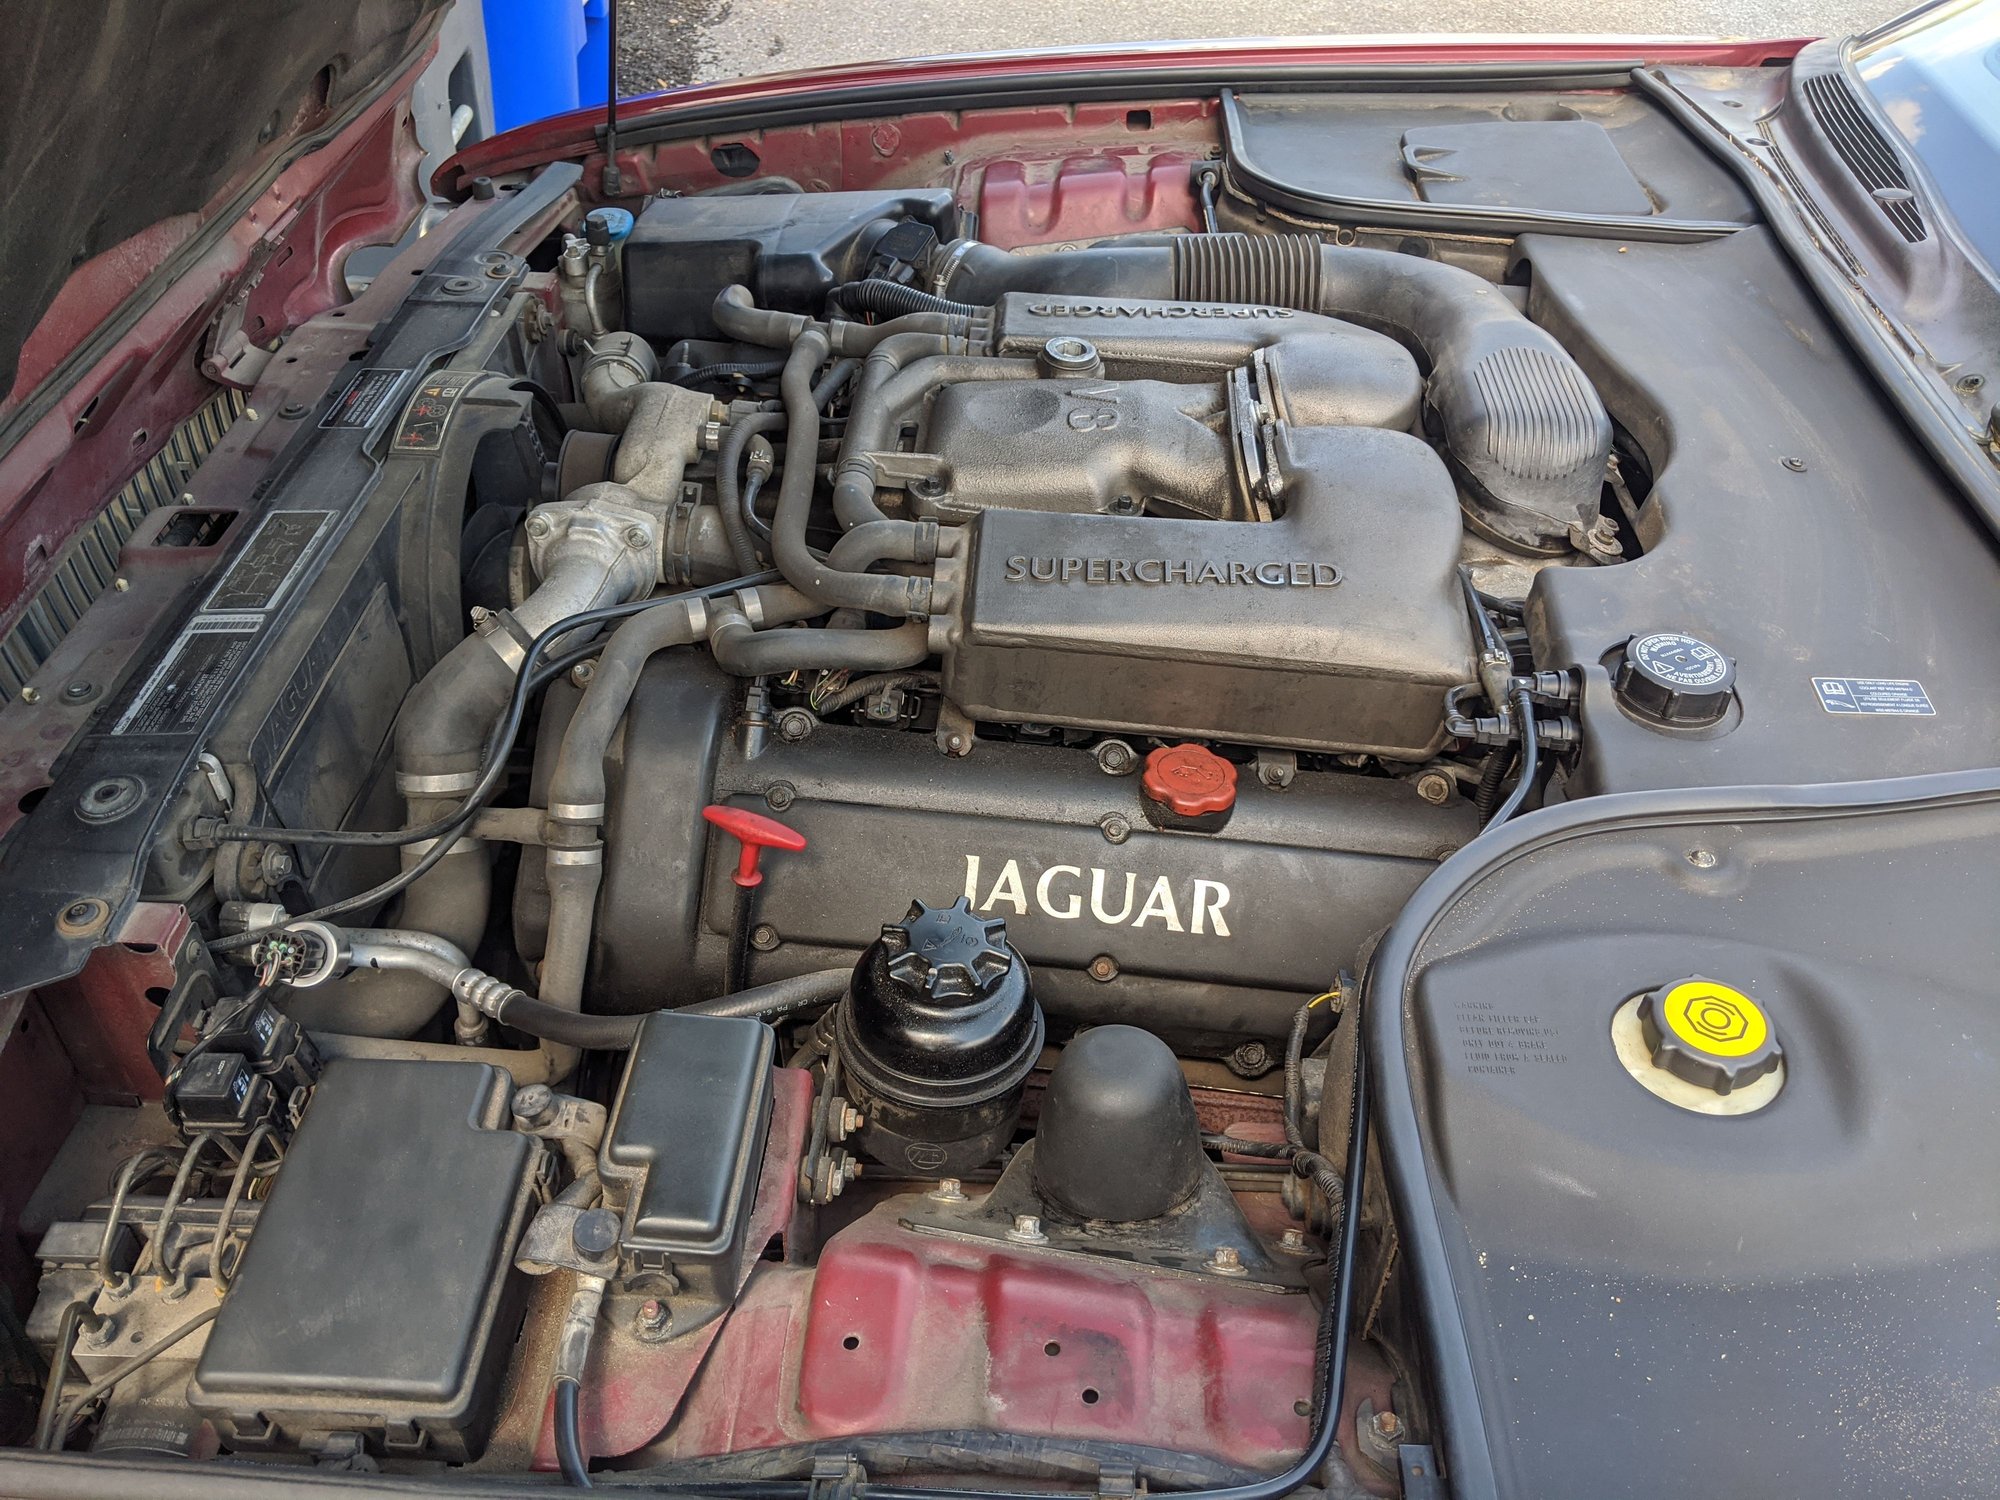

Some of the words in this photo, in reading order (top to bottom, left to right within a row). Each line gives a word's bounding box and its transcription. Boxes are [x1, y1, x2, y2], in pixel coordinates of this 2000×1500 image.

[1028, 304, 1294, 318] SUPERCHARGED
[1065, 383, 1121, 433] V8
[1006, 555, 1343, 589] SUPERCHARGED
[1650, 641, 1677, 652] WARNING
[965, 855, 1232, 938] JAGUAR
[1518, 1041, 1547, 1049] BRAKE
[1534, 1054, 1568, 1063] SEALED
